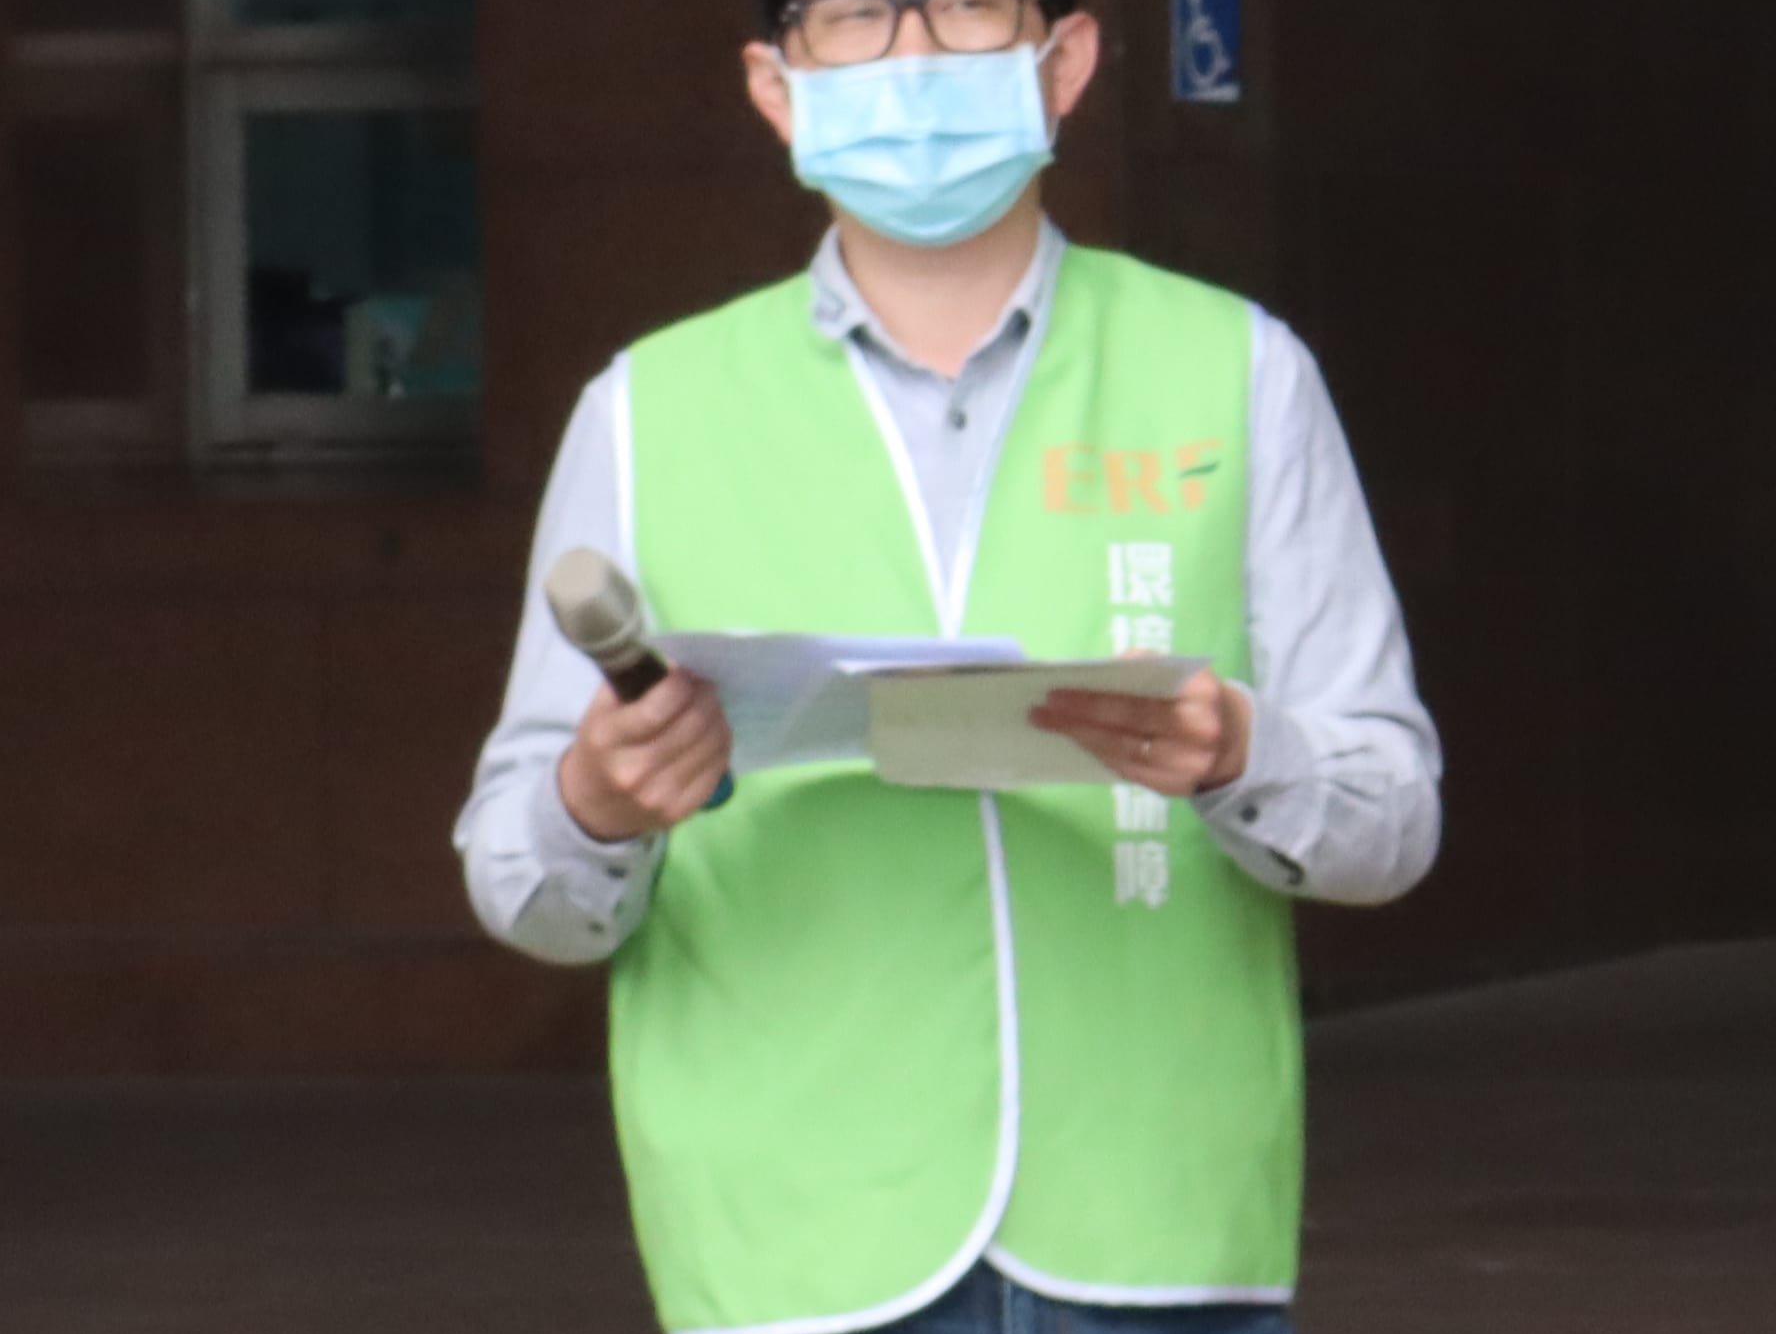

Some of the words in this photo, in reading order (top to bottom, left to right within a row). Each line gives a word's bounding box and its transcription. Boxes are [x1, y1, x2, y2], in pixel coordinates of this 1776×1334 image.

[1041, 439, 1226, 515] ERF
[1108, 542, 1174, 909] 環境保障
